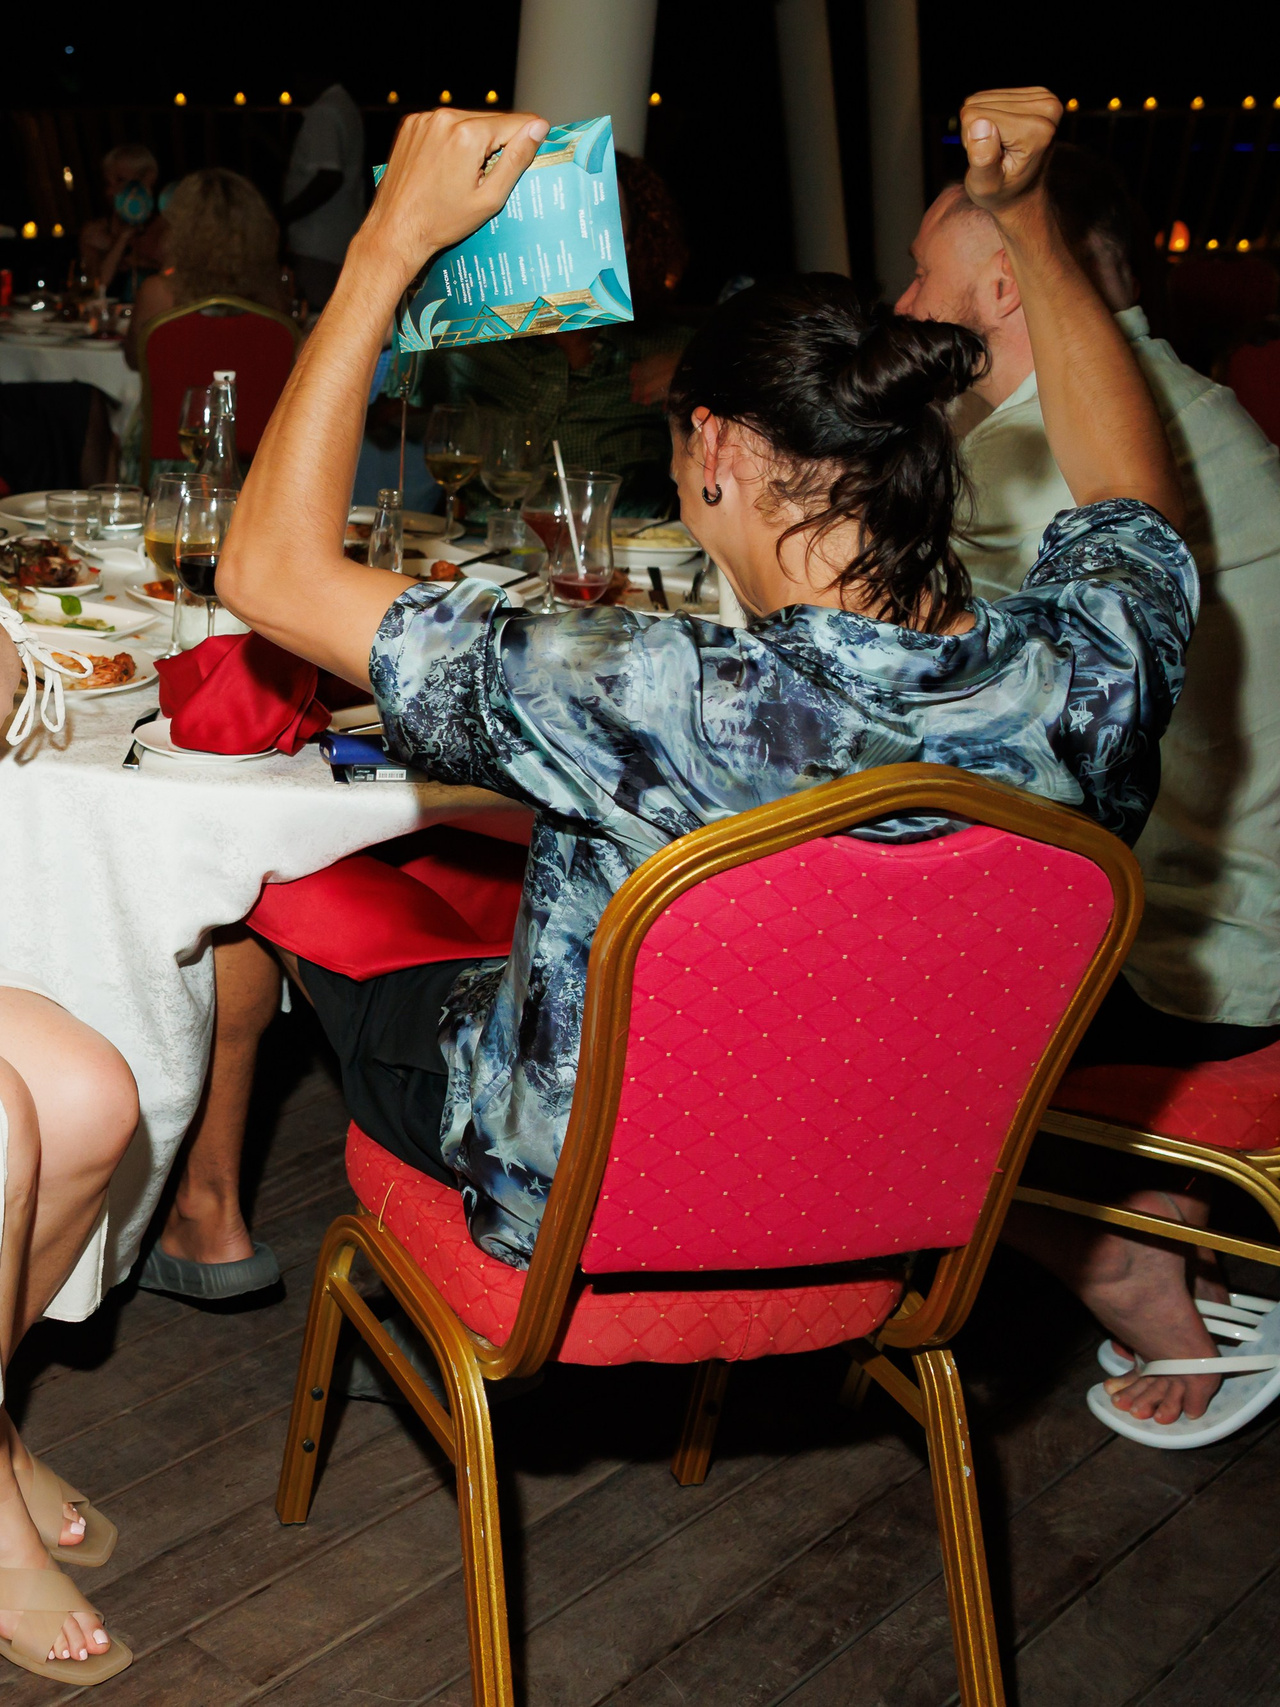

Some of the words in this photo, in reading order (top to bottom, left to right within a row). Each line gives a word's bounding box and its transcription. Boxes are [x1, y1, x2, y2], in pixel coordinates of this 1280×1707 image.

[578, 209, 587, 238] ДЕСЕРТЫ
[442, 269, 452, 296] ЗАКУСКИ
[518, 256, 527, 285] ГАРНИРЫ
